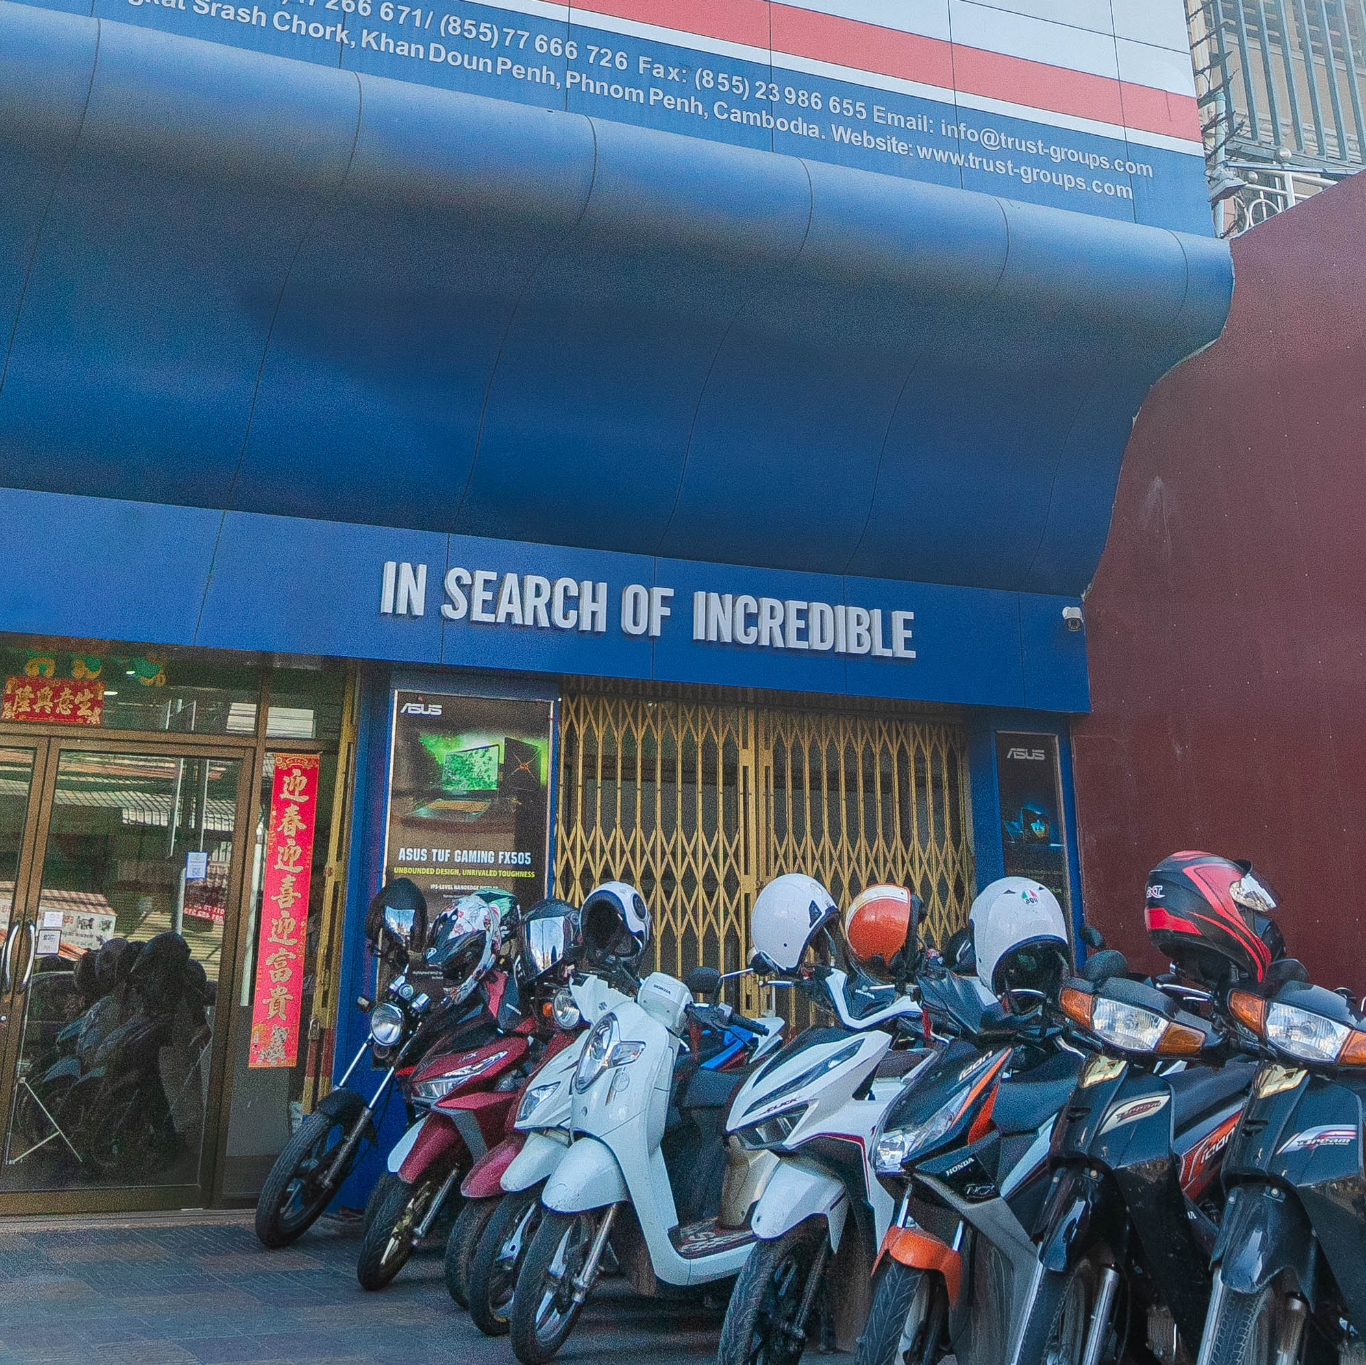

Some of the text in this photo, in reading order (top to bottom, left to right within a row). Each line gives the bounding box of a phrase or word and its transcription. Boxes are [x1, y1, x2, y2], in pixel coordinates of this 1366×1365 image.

[379, 1, 434, 30] 671/
[439, 13, 500, 48] (855)
[502, 27, 531, 50] 77
[534, 33, 579, 60] 666
[586, 44, 629, 71] 726
[638, 55, 688, 84] Fax:
[694, 66, 751, 101] (855)
[754, 80, 781, 103] 23
[784, 87, 823, 111] 986
[828, 95, 868, 121] 655
[873, 105, 935, 134] Email:
[940, 118, 1154, 179] info@trust-groups.com
[272, 10, 357, 50] Chork,
[361, 29, 426, 60] Khan
[428, 43, 493, 74] Doun
[496, 58, 562, 90] Penh,
[565, 70, 645, 103] Phnom
[649, 86, 710, 120] Penh,
[713, 100, 826, 140] Cambodia.
[831, 123, 914, 157] Website:
[916, 143, 1135, 200] www.trust-groups.com
[380, 560, 917, 659] IN SEARCH OF INCREDIBLE
[400, 701, 443, 717] ASUS
[1006, 747, 1045, 761] ASUS
[398, 847, 532, 865] ASUS TUF GAMING FX505
[393, 866, 535, 878] UNBOUNDED DESIGN, UNRIVALED TOUGHNESS
[261, 768, 309, 1022] 迎春迎喜迎富貴
[945, 1157, 975, 1177] HONDA
